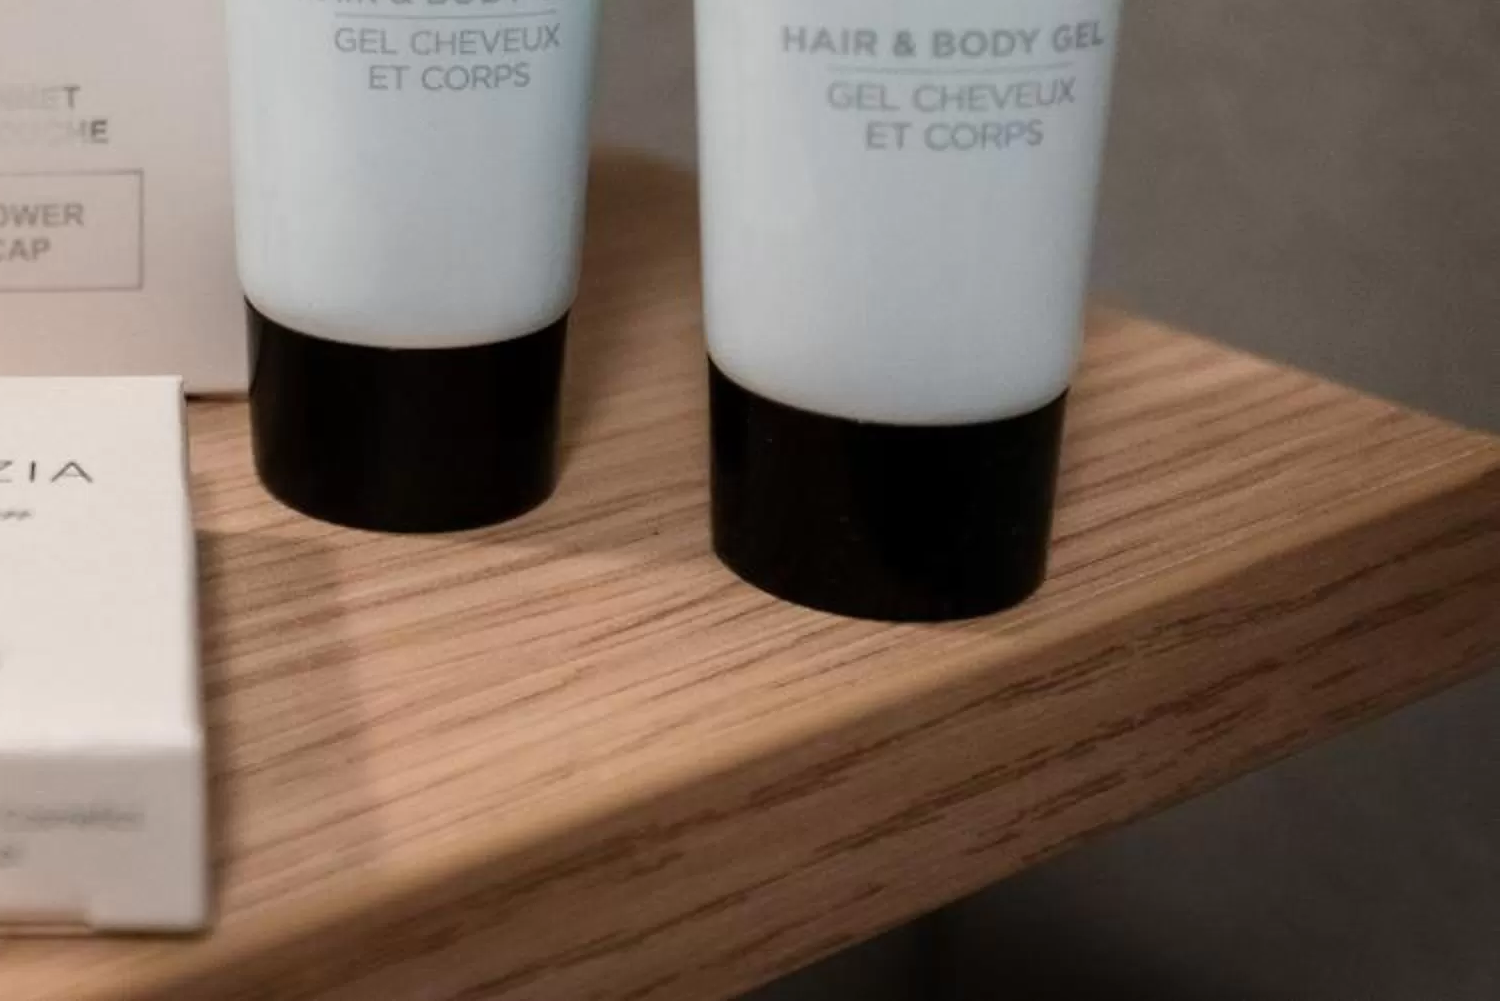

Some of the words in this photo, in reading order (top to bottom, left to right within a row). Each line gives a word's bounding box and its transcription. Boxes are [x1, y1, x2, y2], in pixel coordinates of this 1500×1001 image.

[334, 27, 397, 56] GEL
[409, 23, 561, 57] CHEVEUX
[781, 25, 878, 58] HAIR
[892, 28, 917, 58] &
[931, 27, 1041, 59] BODY
[1051, 20, 1105, 51] GEL
[368, 64, 411, 91] ET
[421, 62, 531, 92] CORPS
[826, 81, 900, 113] GEL
[911, 76, 1077, 113] CHEVEUX
[865, 120, 913, 150] ET
[923, 118, 1045, 151] CORPS
